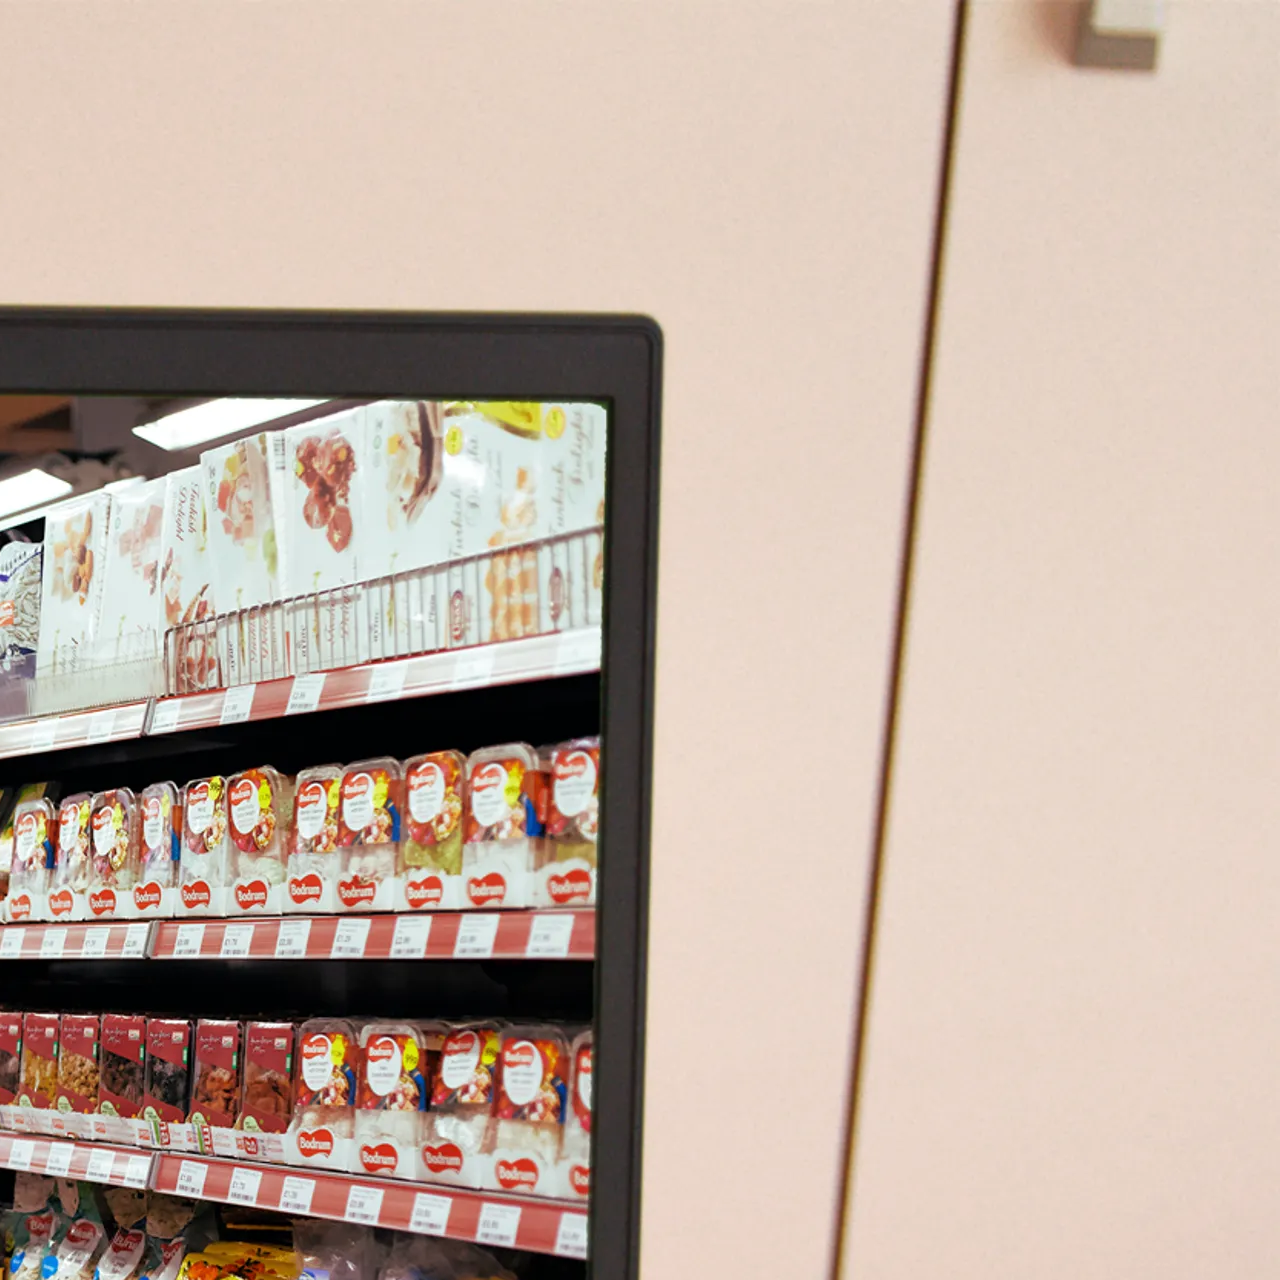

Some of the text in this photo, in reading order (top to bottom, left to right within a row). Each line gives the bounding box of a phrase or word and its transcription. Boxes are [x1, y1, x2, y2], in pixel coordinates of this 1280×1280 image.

[290, 882, 321, 896] Bodrum
[340, 885, 374, 900] Bodrum
[407, 886, 441, 900] Bodrum
[470, 882, 505, 897] Bodrum
[551, 879, 590, 895] Bodrum
[135, 889, 160, 903] Bodrum
[182, 888, 209, 902] Bodrum
[237, 889, 266, 902] Bodrum
[299, 1137, 332, 1152] Bodrum
[362, 1150, 398, 1167] Bodrum
[424, 1150, 461, 1167] Bodrum
[498, 1166, 538, 1183] Bodrum
